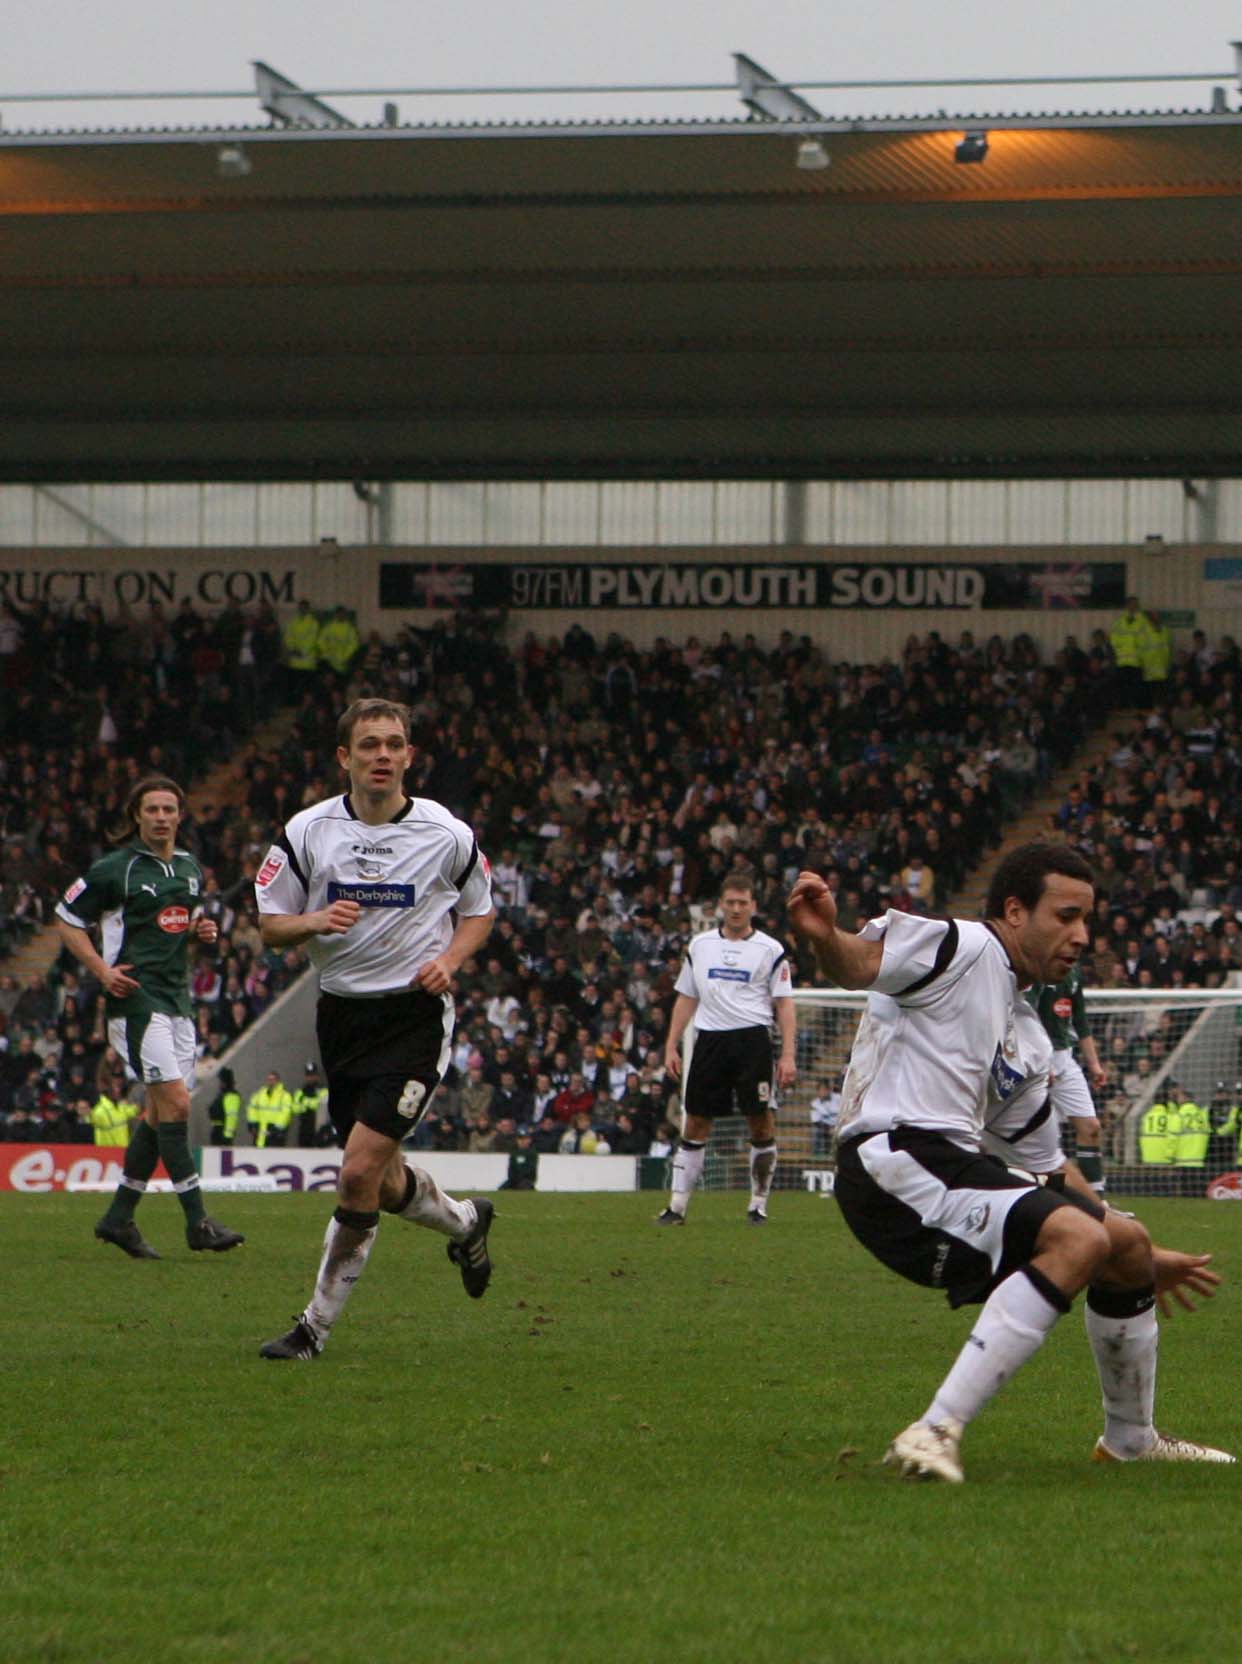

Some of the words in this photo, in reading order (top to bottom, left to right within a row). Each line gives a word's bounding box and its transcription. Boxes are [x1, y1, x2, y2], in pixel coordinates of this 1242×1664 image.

[512, 568, 583, 604] 97FM
[590, 568, 817, 605] PLYMOUTH
[831, 567, 986, 607] SOUND
[397, 1079, 426, 1119] 8
